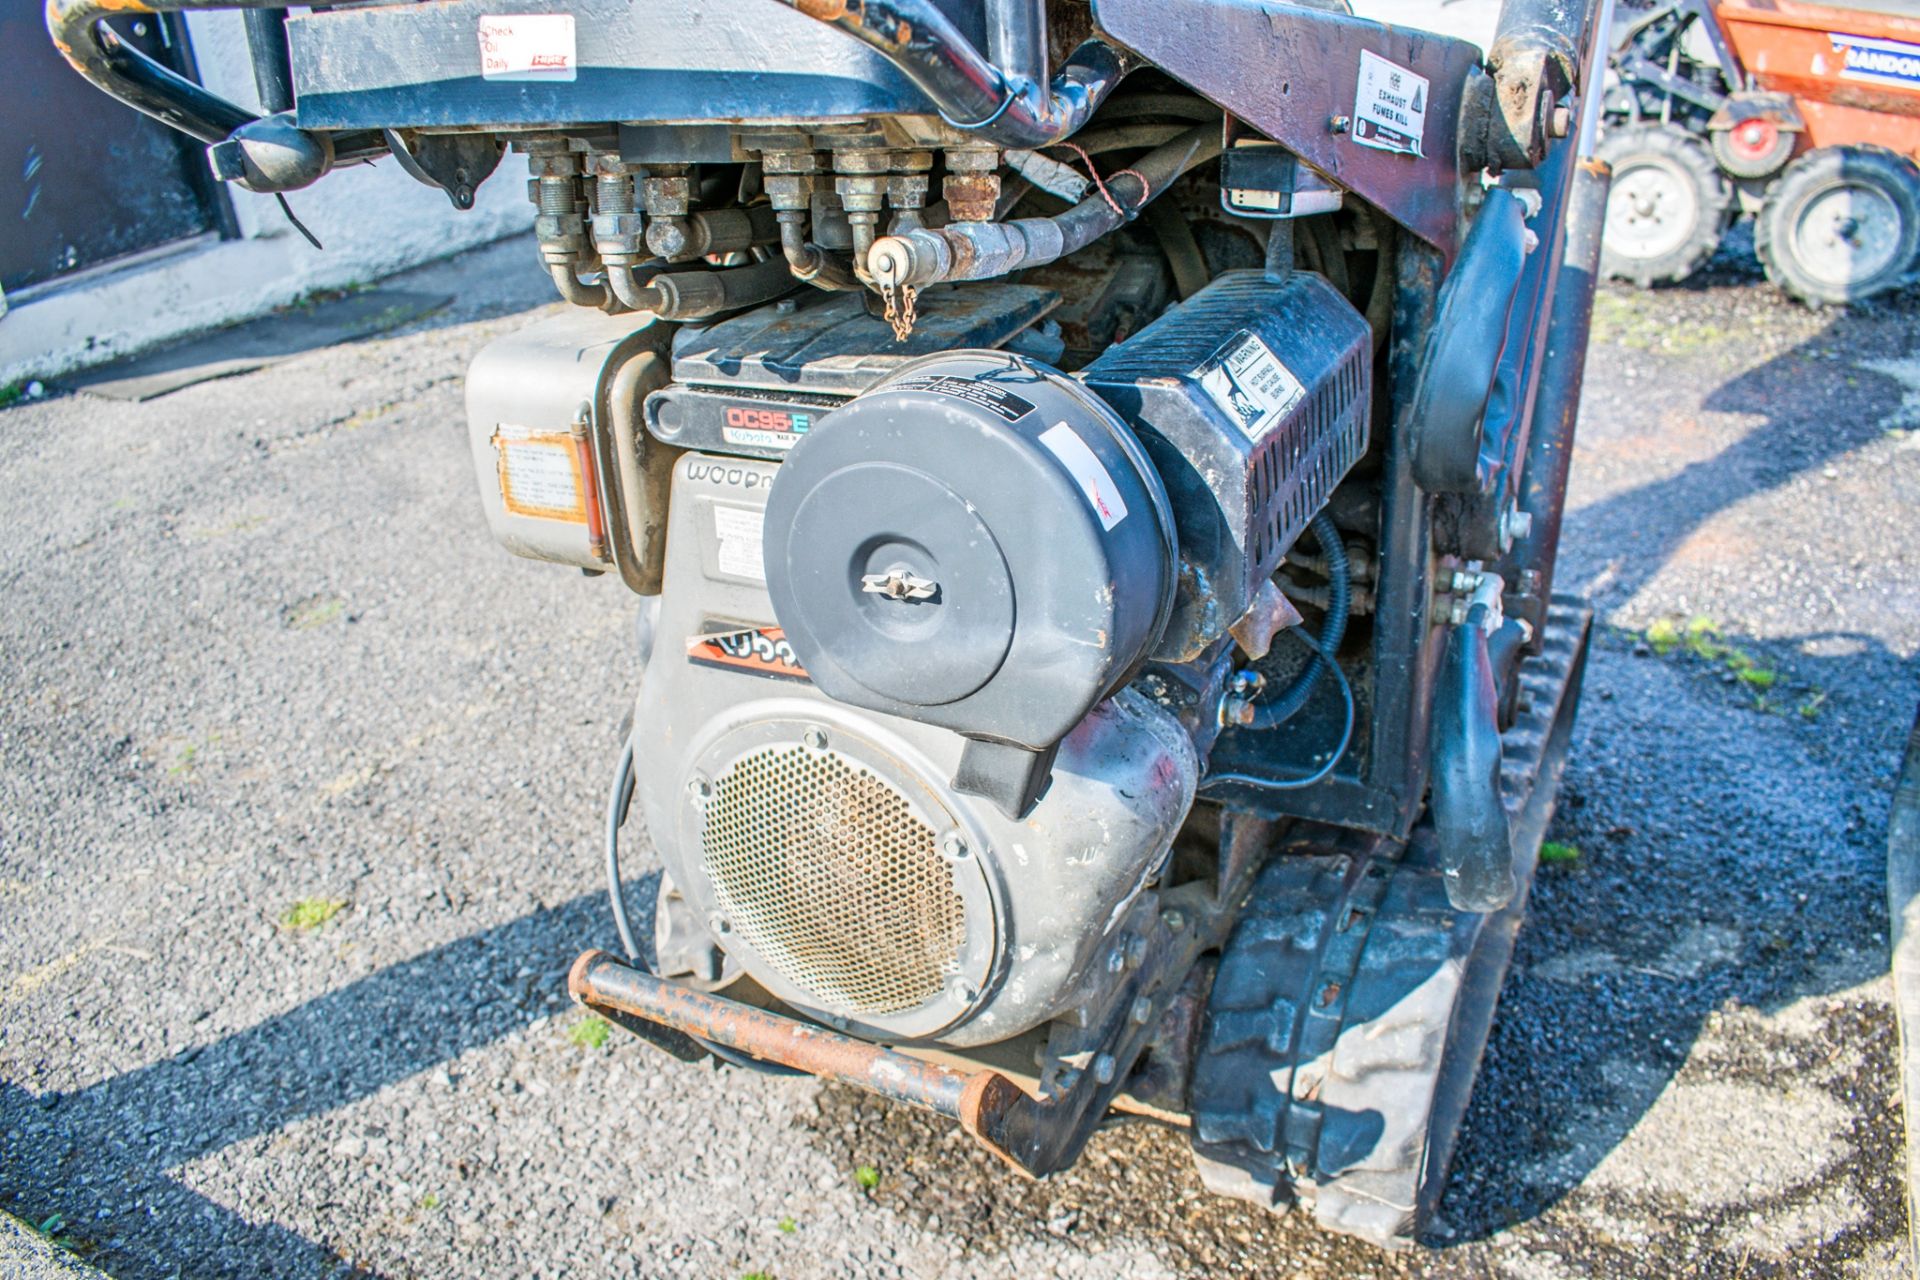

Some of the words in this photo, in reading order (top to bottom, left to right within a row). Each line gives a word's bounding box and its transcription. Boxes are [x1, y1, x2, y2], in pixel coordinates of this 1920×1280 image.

[485, 25, 514, 37] Check
[485, 41, 498, 53] Oil
[487, 58, 509, 70] Daily
[1378, 89, 1407, 109] EXHAUST
[1372, 103, 1394, 121] FUMES
[1395, 111, 1409, 126] KILL
[1235, 340, 1261, 365] WARNING
[730, 430, 773, 444] Kubota
